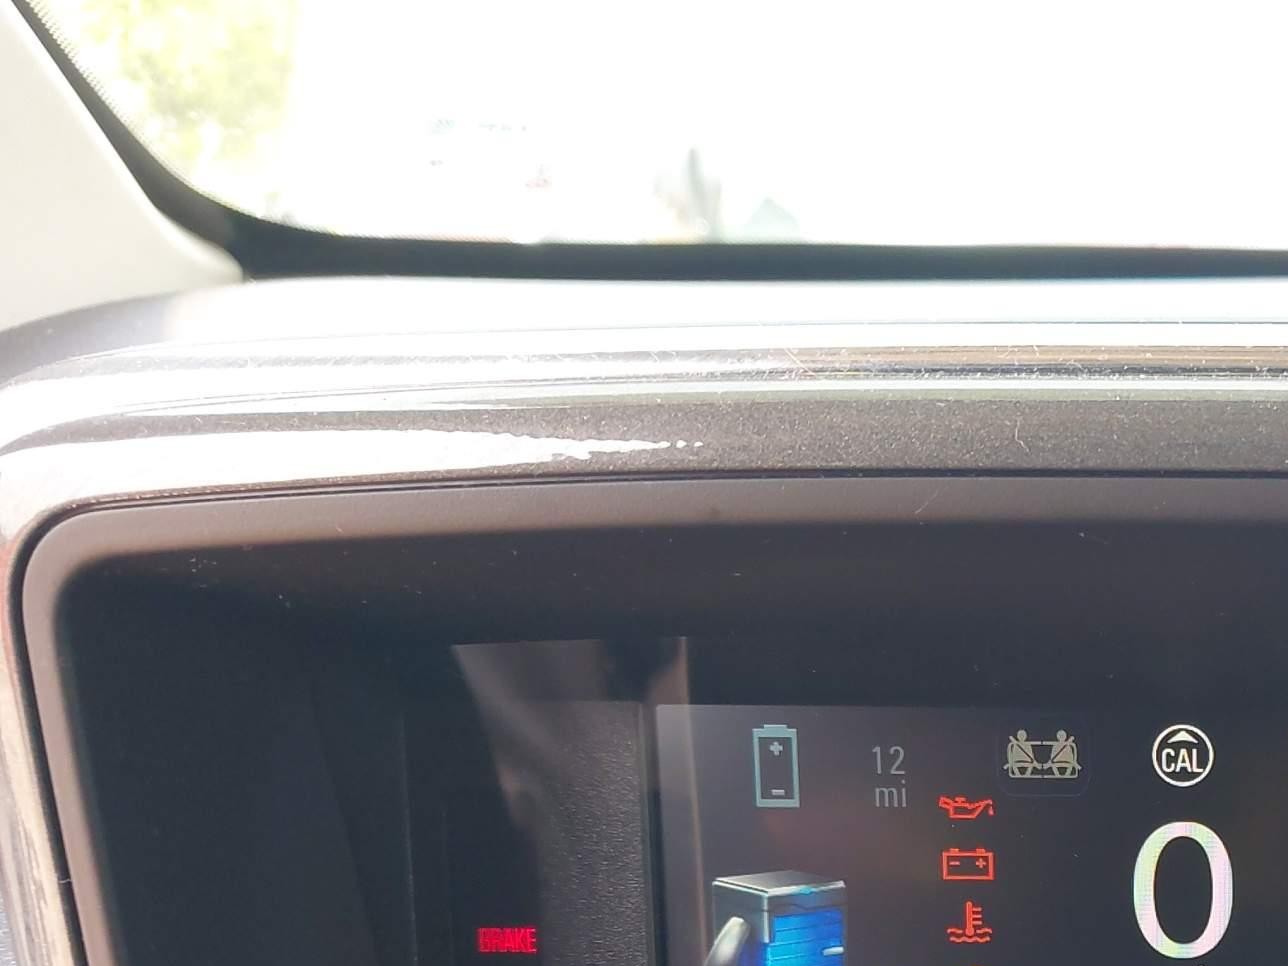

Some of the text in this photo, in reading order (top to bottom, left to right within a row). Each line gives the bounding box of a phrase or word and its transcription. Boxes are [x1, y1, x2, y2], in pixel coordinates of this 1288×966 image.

[872, 746, 906, 775] 12
[1161, 748, 1204, 773] CAL
[875, 781, 908, 808] mi
[1133, 821, 1233, 959] 0
[477, 927, 537, 953] BRAKE
